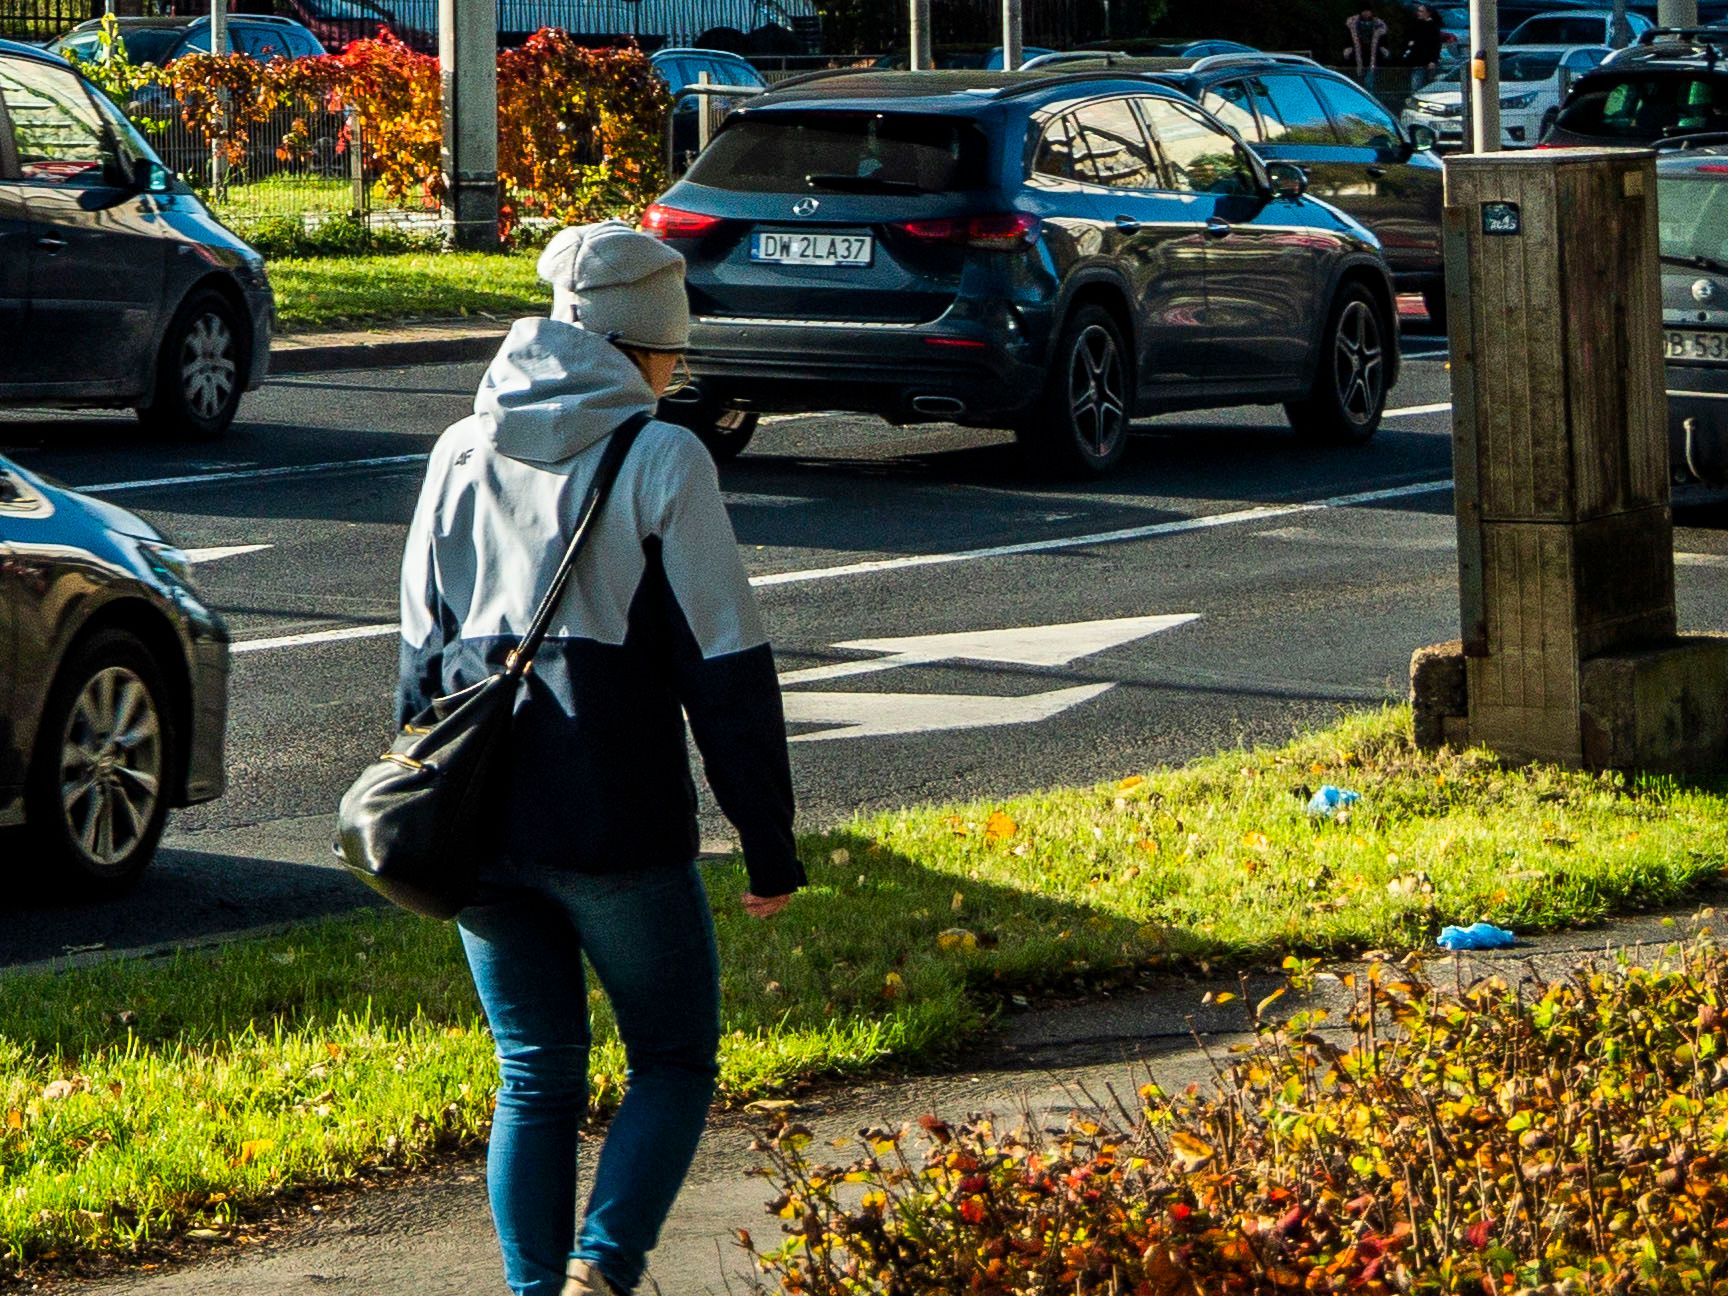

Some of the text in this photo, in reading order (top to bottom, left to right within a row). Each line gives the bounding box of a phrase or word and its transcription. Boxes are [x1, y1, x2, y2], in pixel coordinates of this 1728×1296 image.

[764, 235, 866, 260] DW 2LA37
[1663, 332, 1728, 358] B 53
